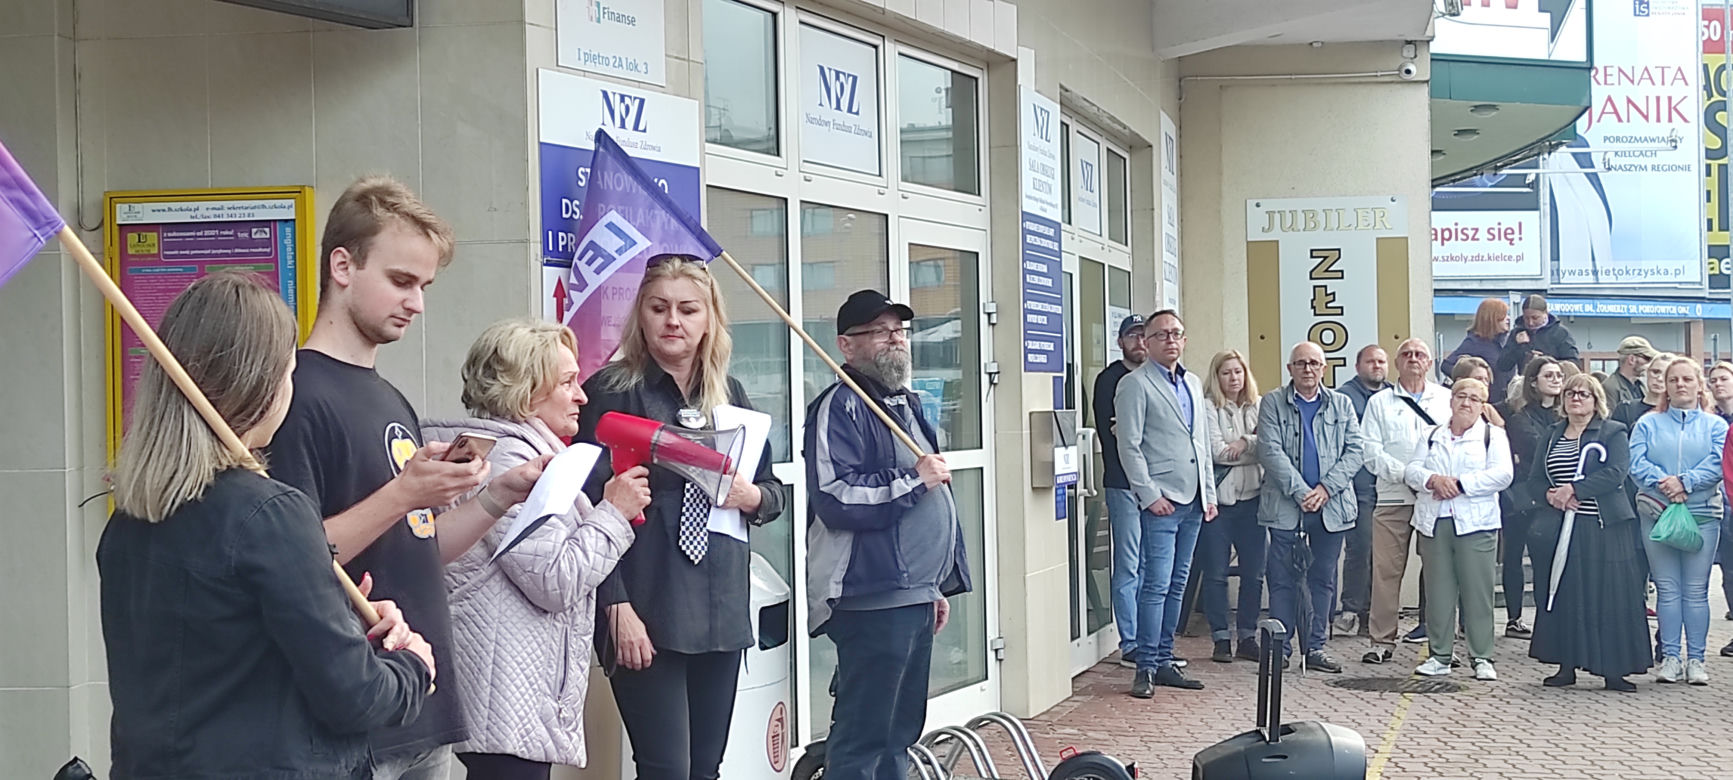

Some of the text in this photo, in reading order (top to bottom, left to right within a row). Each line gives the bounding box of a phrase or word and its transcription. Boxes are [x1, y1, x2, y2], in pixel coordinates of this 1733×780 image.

[602, 6, 636, 27] Finanse
[577, 47, 649, 75] I piętro 2A lok. 3
[1592, 66, 1689, 86] RENATA
[817, 64, 860, 116] NFZ
[600, 89, 647, 133] NFZ
[1032, 103, 1051, 143] NFZ
[1584, 95, 1691, 134] JANIK
[805, 113, 873, 139] Narodowy Fundusz Zdrowia
[1603, 135, 1684, 145] POROZMAWIAJY
[1610, 164, 1692, 173] NASZYM REGIONIE
[561, 198, 584, 220] DS.
[1262, 207, 1392, 233] JUBILER
[548, 230, 553, 252] I
[1431, 221, 1523, 246] apisz się!
[1432, 252, 1524, 264] w.szkoly.zdz.kielce.pl
[1307, 248, 1349, 389] ZŁOT
